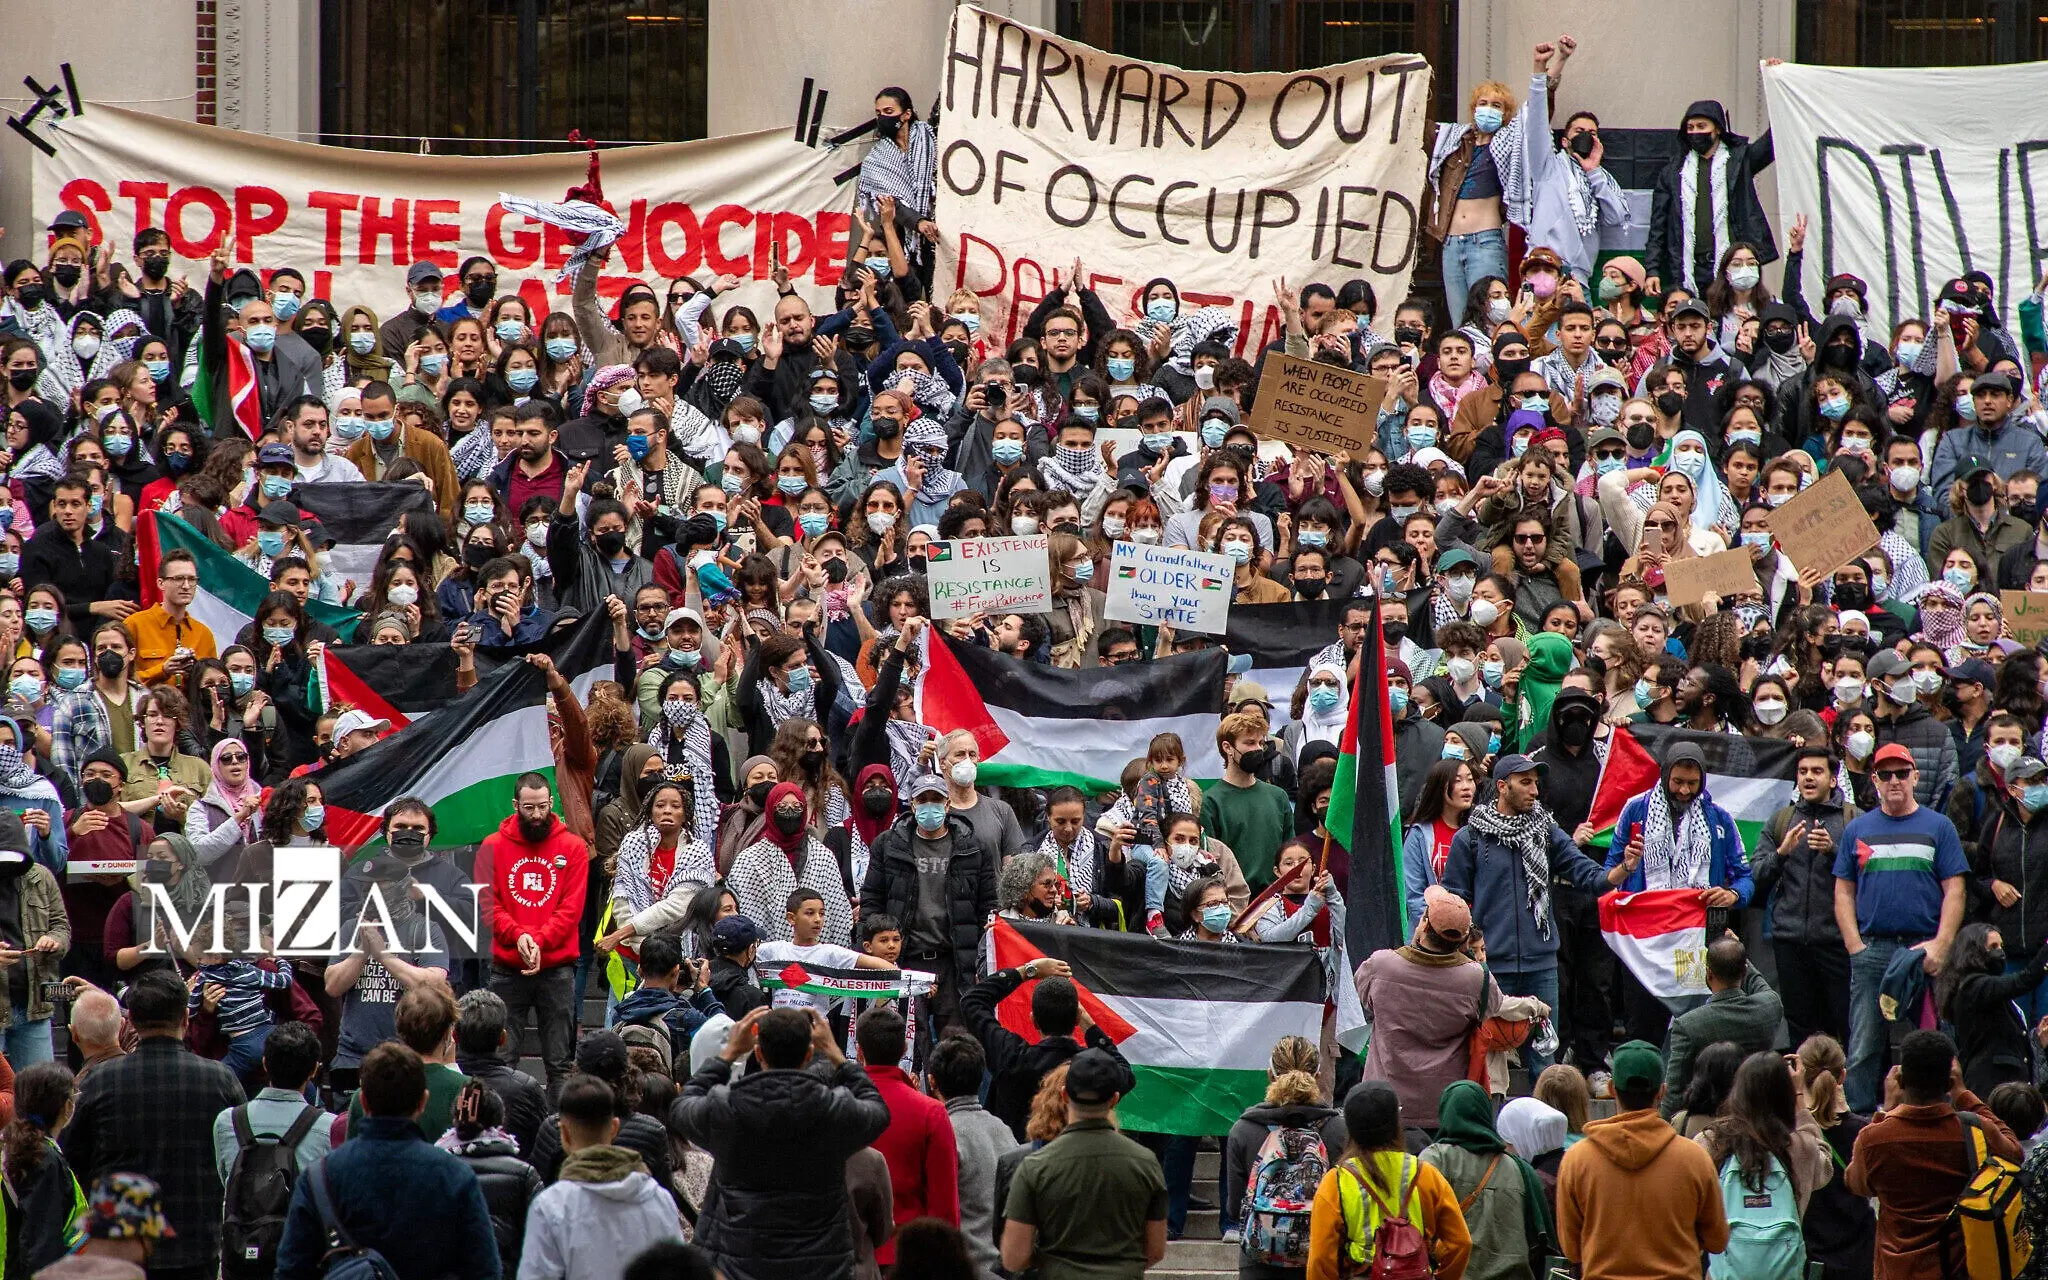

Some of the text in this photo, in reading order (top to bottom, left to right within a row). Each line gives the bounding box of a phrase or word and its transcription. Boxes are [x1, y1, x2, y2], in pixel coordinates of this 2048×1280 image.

[946, 12, 1428, 150] HARVARD OUT
[941, 139, 1417, 275] OF OCCUPIED
[47, 178, 289, 264] STOP
[308, 190, 461, 268] THE
[1283, 362, 1366, 397] WHEN PEOPLE
[1280, 381, 1368, 414] ARE OCCUPIED
[1274, 399, 1344, 427] RESISTANCE
[1274, 420, 1363, 450] IS JUSTIFIED
[962, 539, 1048, 559] EXISTENCE
[1116, 544, 1136, 558] MY
[1145, 549, 1215, 572] Grandfather
[982, 559, 1001, 573] IS
[1140, 568, 1197, 591] OLDER
[951, 593, 1044, 611] #FreePalestine
[1129, 588, 1199, 607] than your
[361, 990, 397, 1002] CAN BE
[822, 978, 891, 990] PALESTINE
